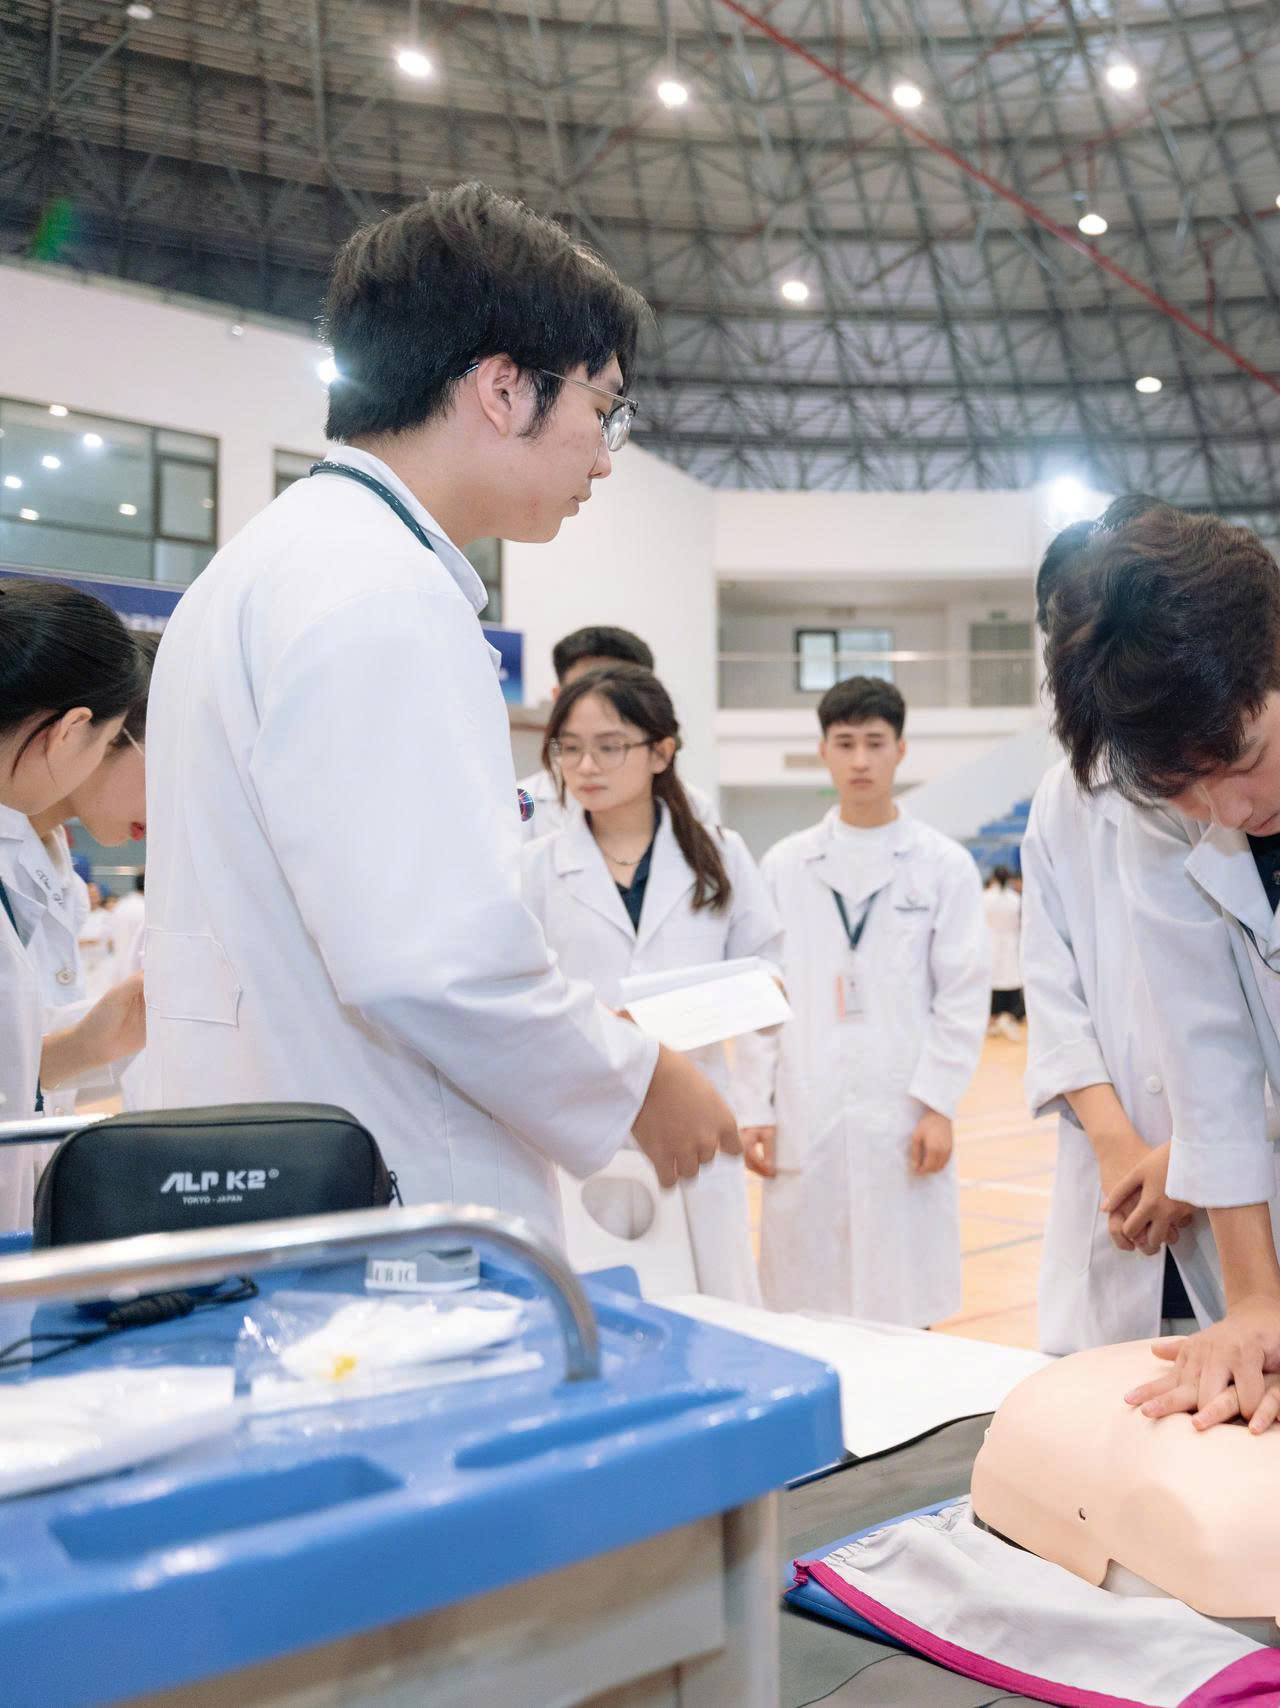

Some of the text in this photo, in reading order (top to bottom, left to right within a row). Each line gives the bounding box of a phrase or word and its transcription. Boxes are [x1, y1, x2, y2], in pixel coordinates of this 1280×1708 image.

[160, 1171, 219, 1193] ALP
[182, 1195, 211, 1204] TOKYO
[216, 1195, 242, 1203] JAPAN
